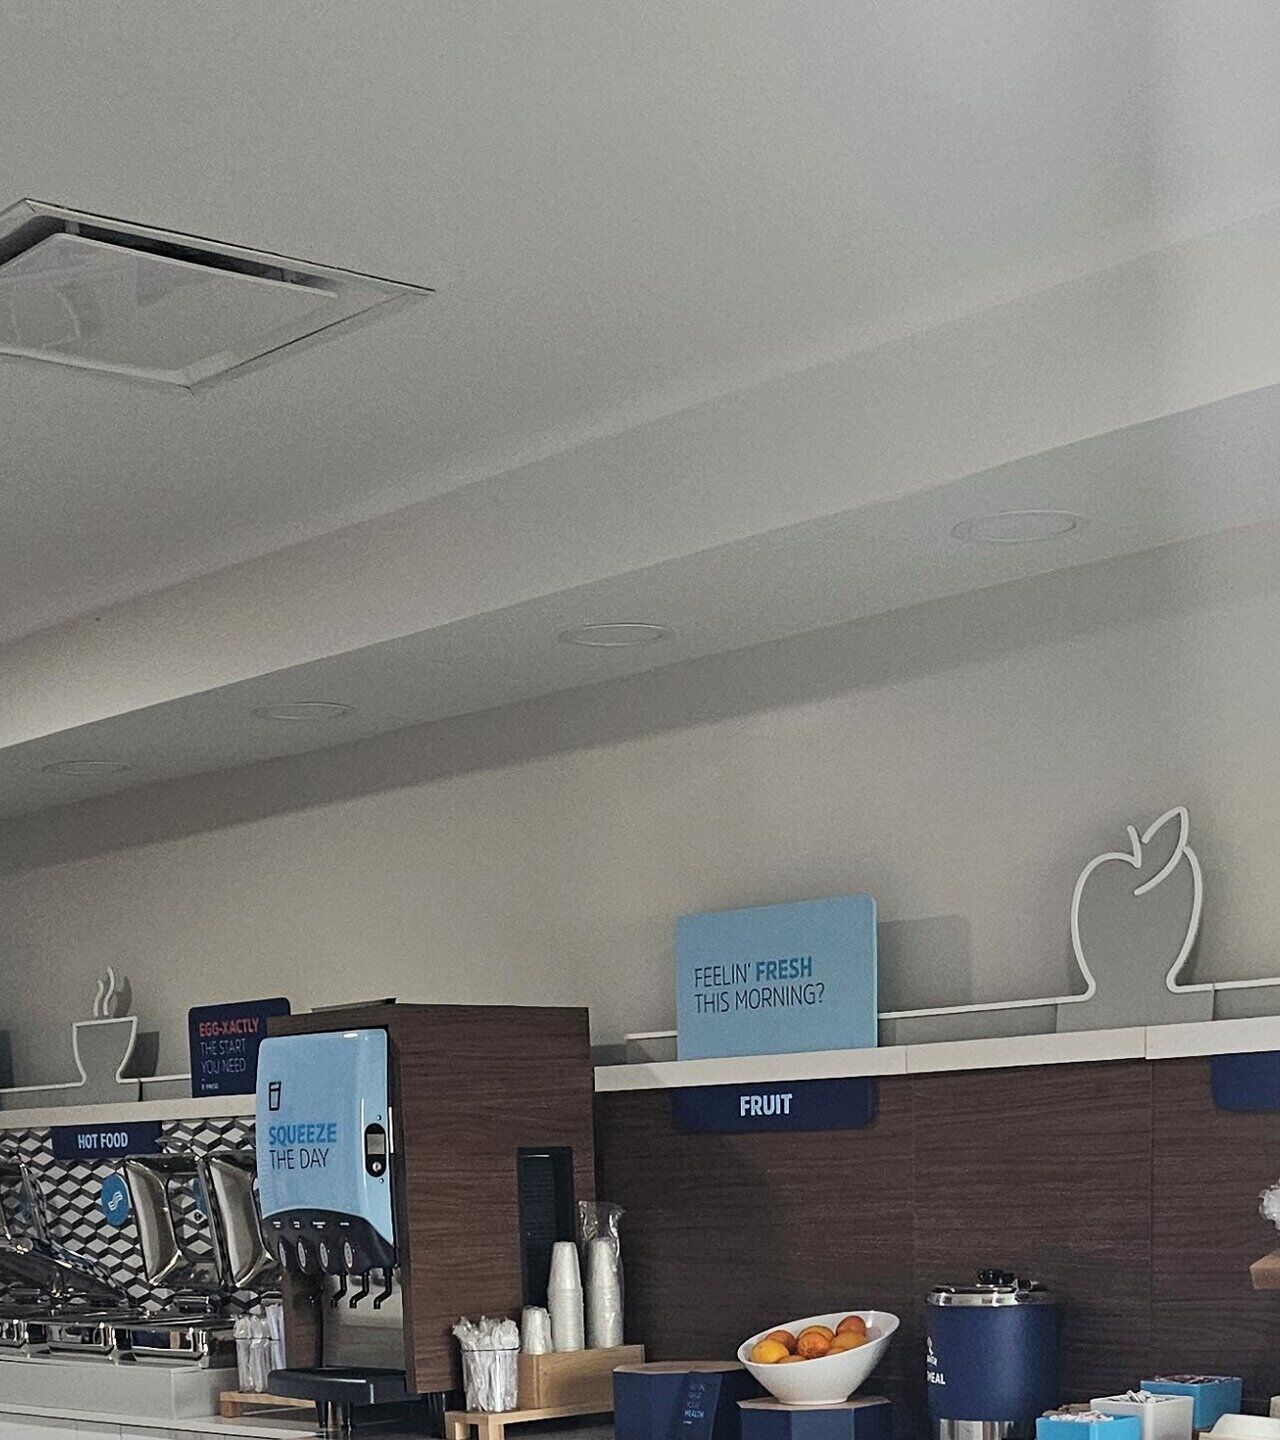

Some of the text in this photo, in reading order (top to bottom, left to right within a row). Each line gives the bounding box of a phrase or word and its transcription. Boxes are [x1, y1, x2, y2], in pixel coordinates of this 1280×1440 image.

[694, 956, 812, 988] FEELIN' FRESH
[694, 982, 825, 1014] THIS MORNING?
[200, 1038, 246, 1057] THE START
[201, 1057, 247, 1075] YOU NEED
[740, 1093, 793, 1117] FRUIT
[78, 1132, 129, 1149] HOT FOOD
[269, 1123, 338, 1147] SQUEEZE
[269, 1148, 330, 1170] THE DAY
